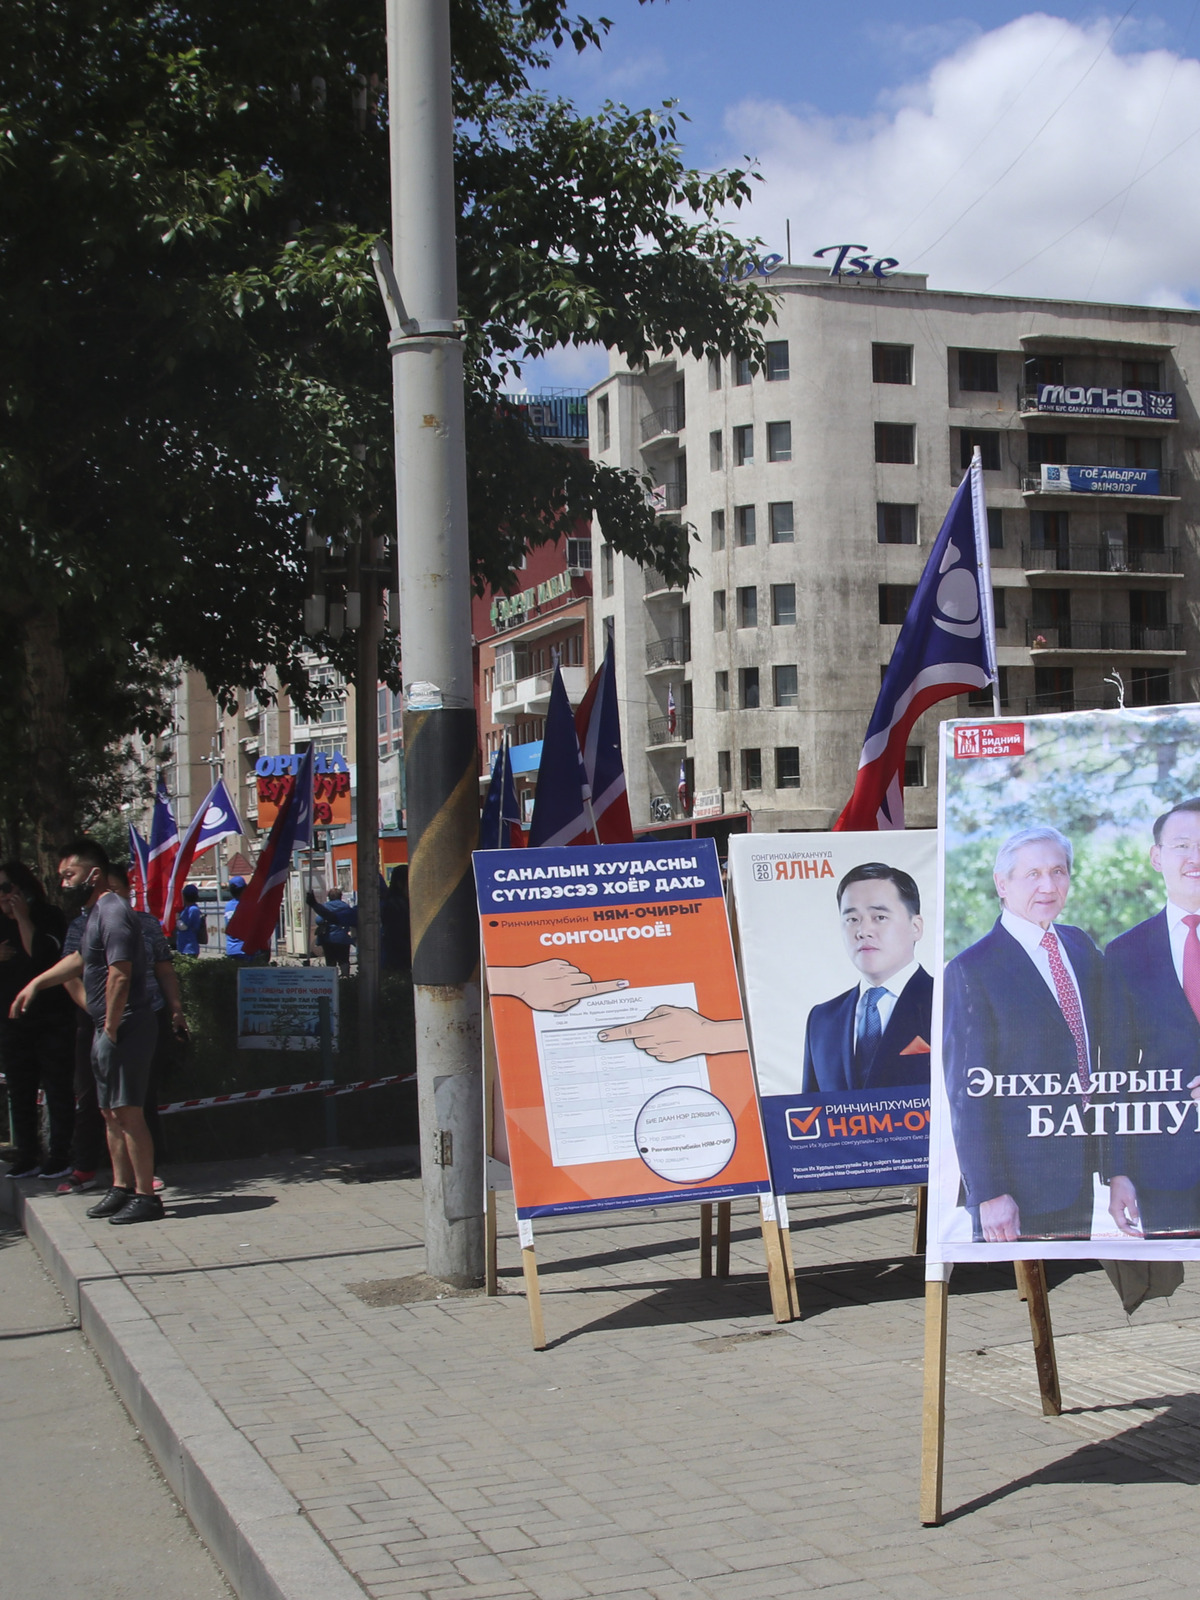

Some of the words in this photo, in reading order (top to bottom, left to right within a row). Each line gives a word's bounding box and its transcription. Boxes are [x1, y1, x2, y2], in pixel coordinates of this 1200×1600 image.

[812, 244, 899, 278] Tse
[1149, 395, 1173, 407] 702
[1080, 468, 1098, 478] ГОЁ
[1100, 470, 1147, 481] АМЬДРАЛ
[1091, 481, 1137, 492] ЭМНЭЛЭГ
[982, 729, 993, 737] ТА
[982, 734, 1021, 747] БИДНИЙ
[982, 746, 1010, 754] ЭВСЭЛ
[751, 851, 832, 861] СОНГИНОХАЙРХАНЧУУД
[493, 864, 590, 882] САНАЛЫН
[593, 857, 698, 876] ХУУДАСНЫ
[756, 864, 768, 872] 20
[775, 860, 835, 880] ЯЛНА
[491, 882, 599, 902] СҮҮЛЭЭСЭЭ
[602, 877, 650, 895] ХОЁР
[655, 876, 706, 893] ДАХЬ
[501, 915, 589, 929] Ринчинлхүмбийн
[593, 903, 703, 921] НЯМ-ОЧИРЫГ
[539, 921, 672, 946] СОНГОЦГООЁ!
[966, 1067, 1183, 1098] ЭНХБАЯРЫН
[827, 1111, 931, 1137] НЯМ-О
